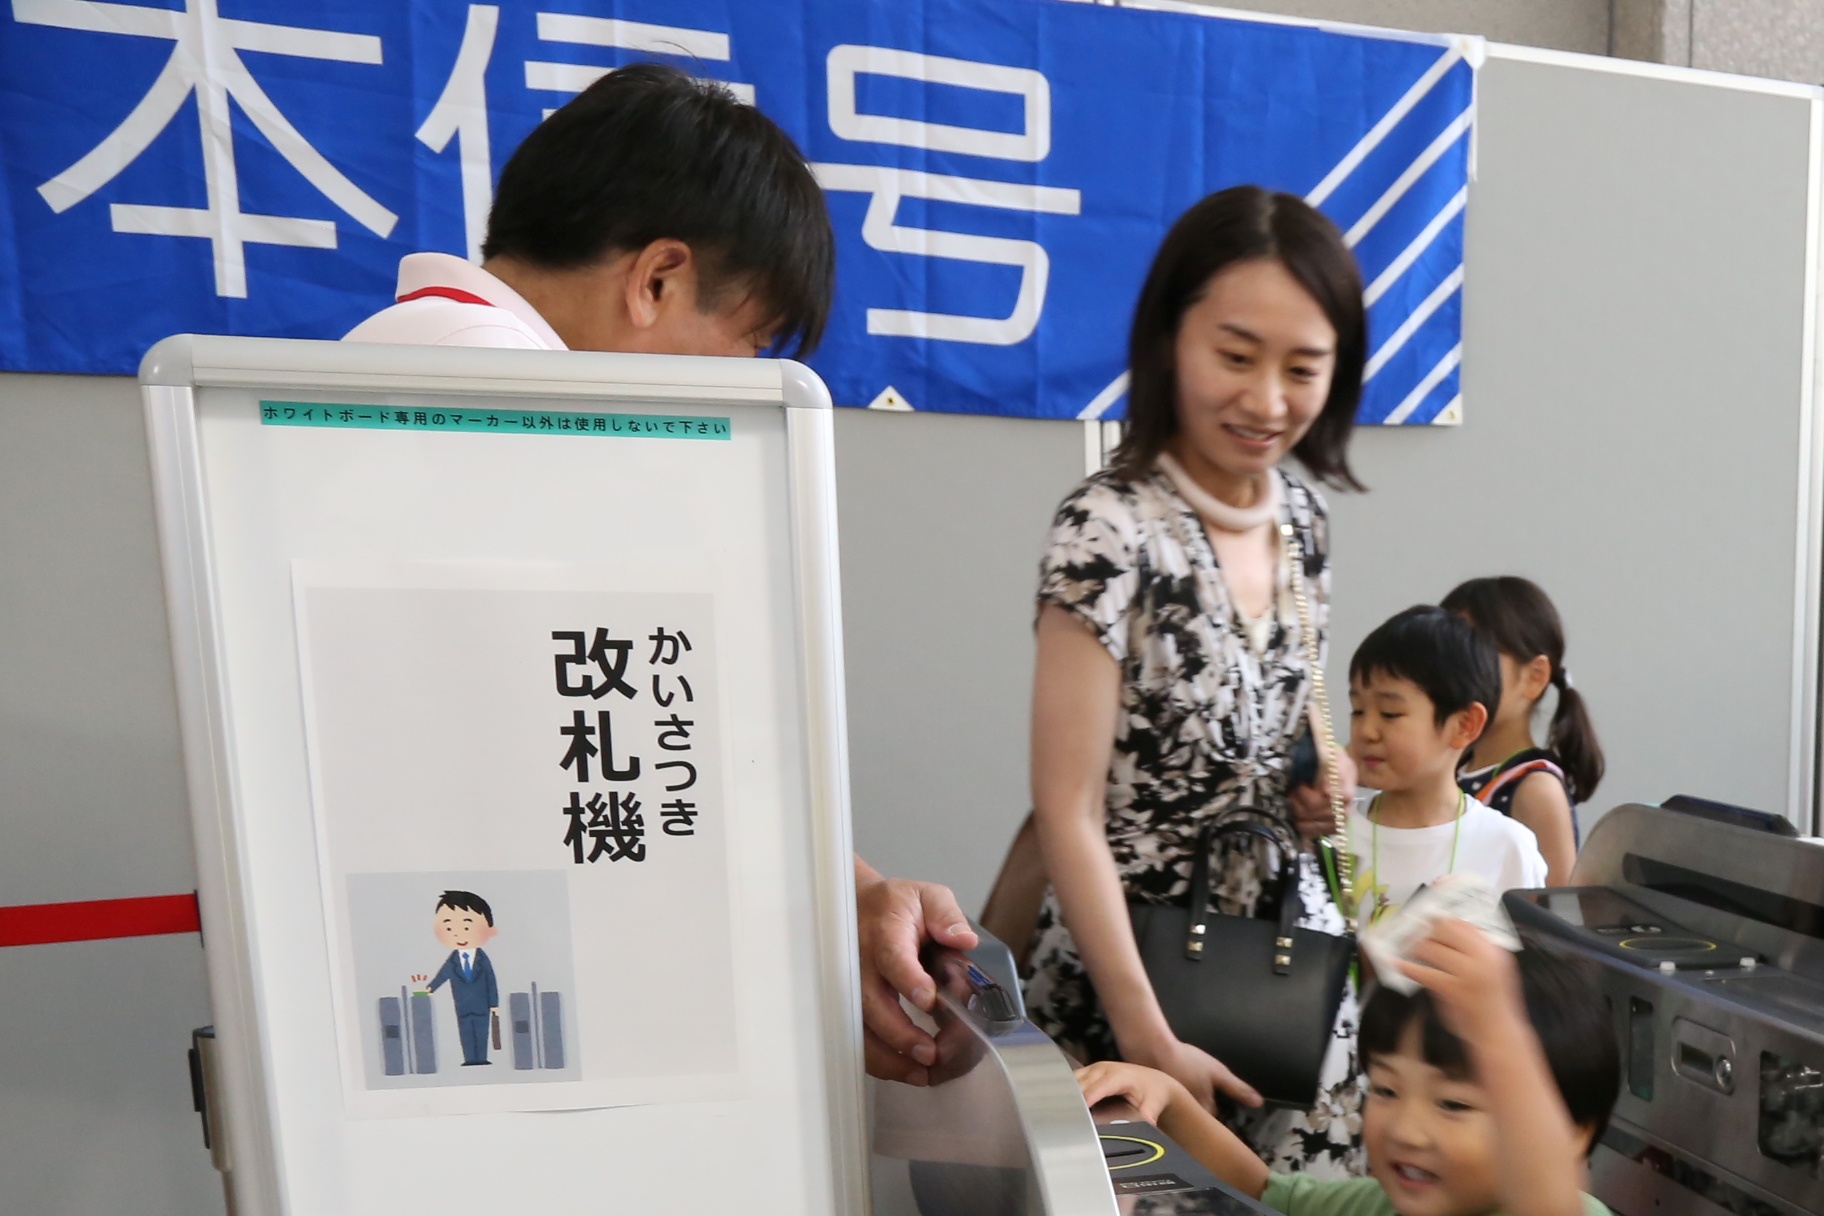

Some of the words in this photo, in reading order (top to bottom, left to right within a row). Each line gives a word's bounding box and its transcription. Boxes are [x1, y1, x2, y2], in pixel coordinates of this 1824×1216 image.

[263, 406, 728, 435] ホワイトボード専用のマーカー以外は使用しないで下さい
[551, 627, 647, 865] 改札機
[647, 626, 699, 837] かいさつき
